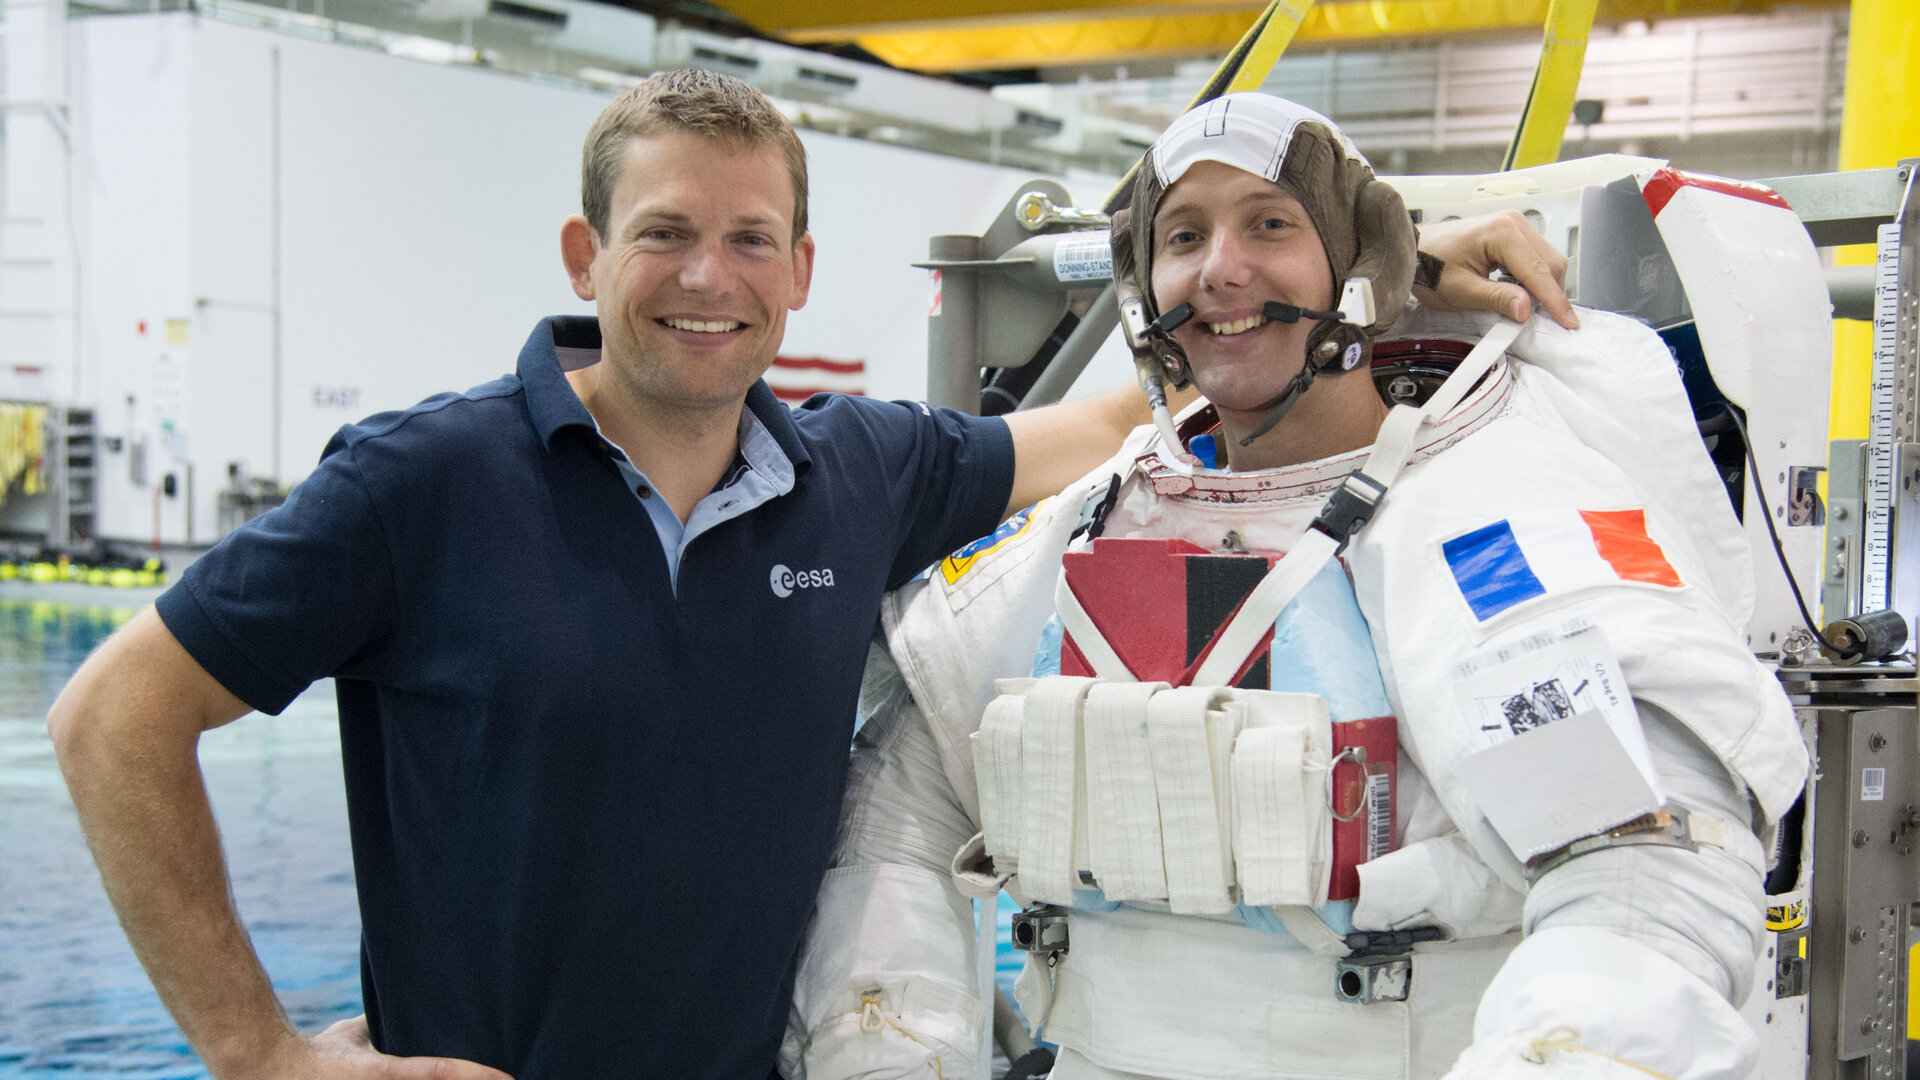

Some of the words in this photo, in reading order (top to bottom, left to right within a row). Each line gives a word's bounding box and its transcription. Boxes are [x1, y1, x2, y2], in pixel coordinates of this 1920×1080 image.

[1877, 253, 1888, 262] 18
[1876, 286, 1887, 295] 17
[1875, 318, 1885, 327] 16
[1873, 351, 1884, 360] 15
[1872, 382, 1883, 391] 14
[1871, 414, 1882, 424] 13
[1869, 447, 1881, 456] 12
[1868, 479, 1878, 488] 11
[1867, 510, 1878, 519] 10
[1867, 542, 1874, 552] 9
[796, 568, 835, 589] esa
[1866, 574, 1872, 584] 8
